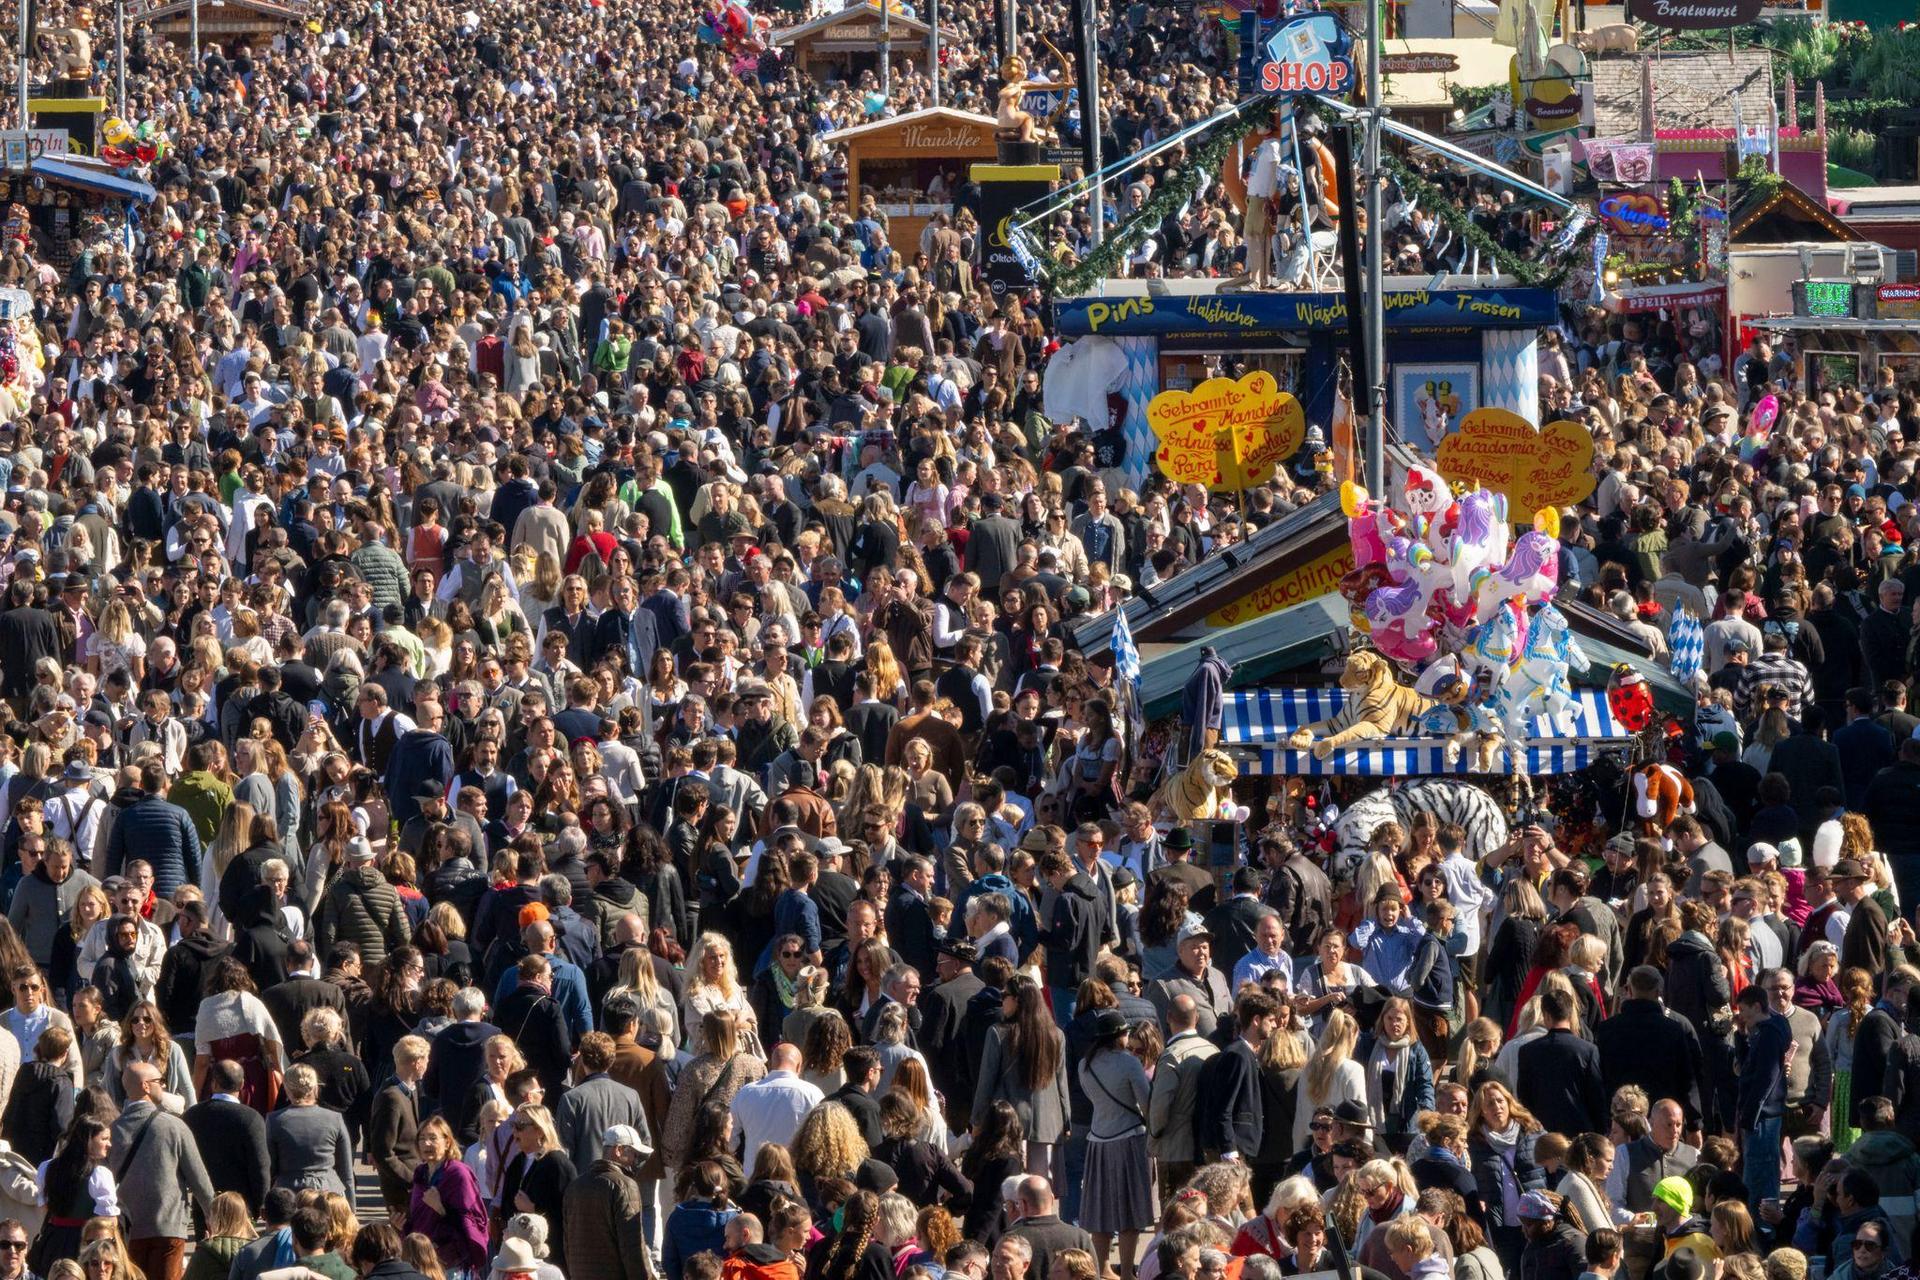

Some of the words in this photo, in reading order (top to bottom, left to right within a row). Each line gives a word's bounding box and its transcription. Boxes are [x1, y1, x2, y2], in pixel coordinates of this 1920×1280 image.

[1653, 0, 1738, 18] Bratwurst
[1262, 62, 1348, 92] SHOP
[1022, 94, 1047, 111] WC
[901, 124, 983, 150] Mandelfee
[1881, 289, 1920, 299] WARNING
[1087, 296, 1155, 332] Pins
[1186, 294, 1259, 327] Halstücher
[1456, 293, 1521, 320] Tassen
[1158, 390, 1241, 419] Gebrannte
[1218, 399, 1290, 427] Mandeln
[1166, 430, 1233, 452] Erdnüsse
[1462, 418, 1533, 439] Gebrannte
[1542, 428, 1581, 452] Cocos
[1241, 428, 1292, 464] Cashew
[1447, 436, 1537, 456] Macadamia
[1172, 454, 1217, 476] Para
[1442, 457, 1511, 485] Walnüsse
[1251, 553, 1356, 612] Wachinge
